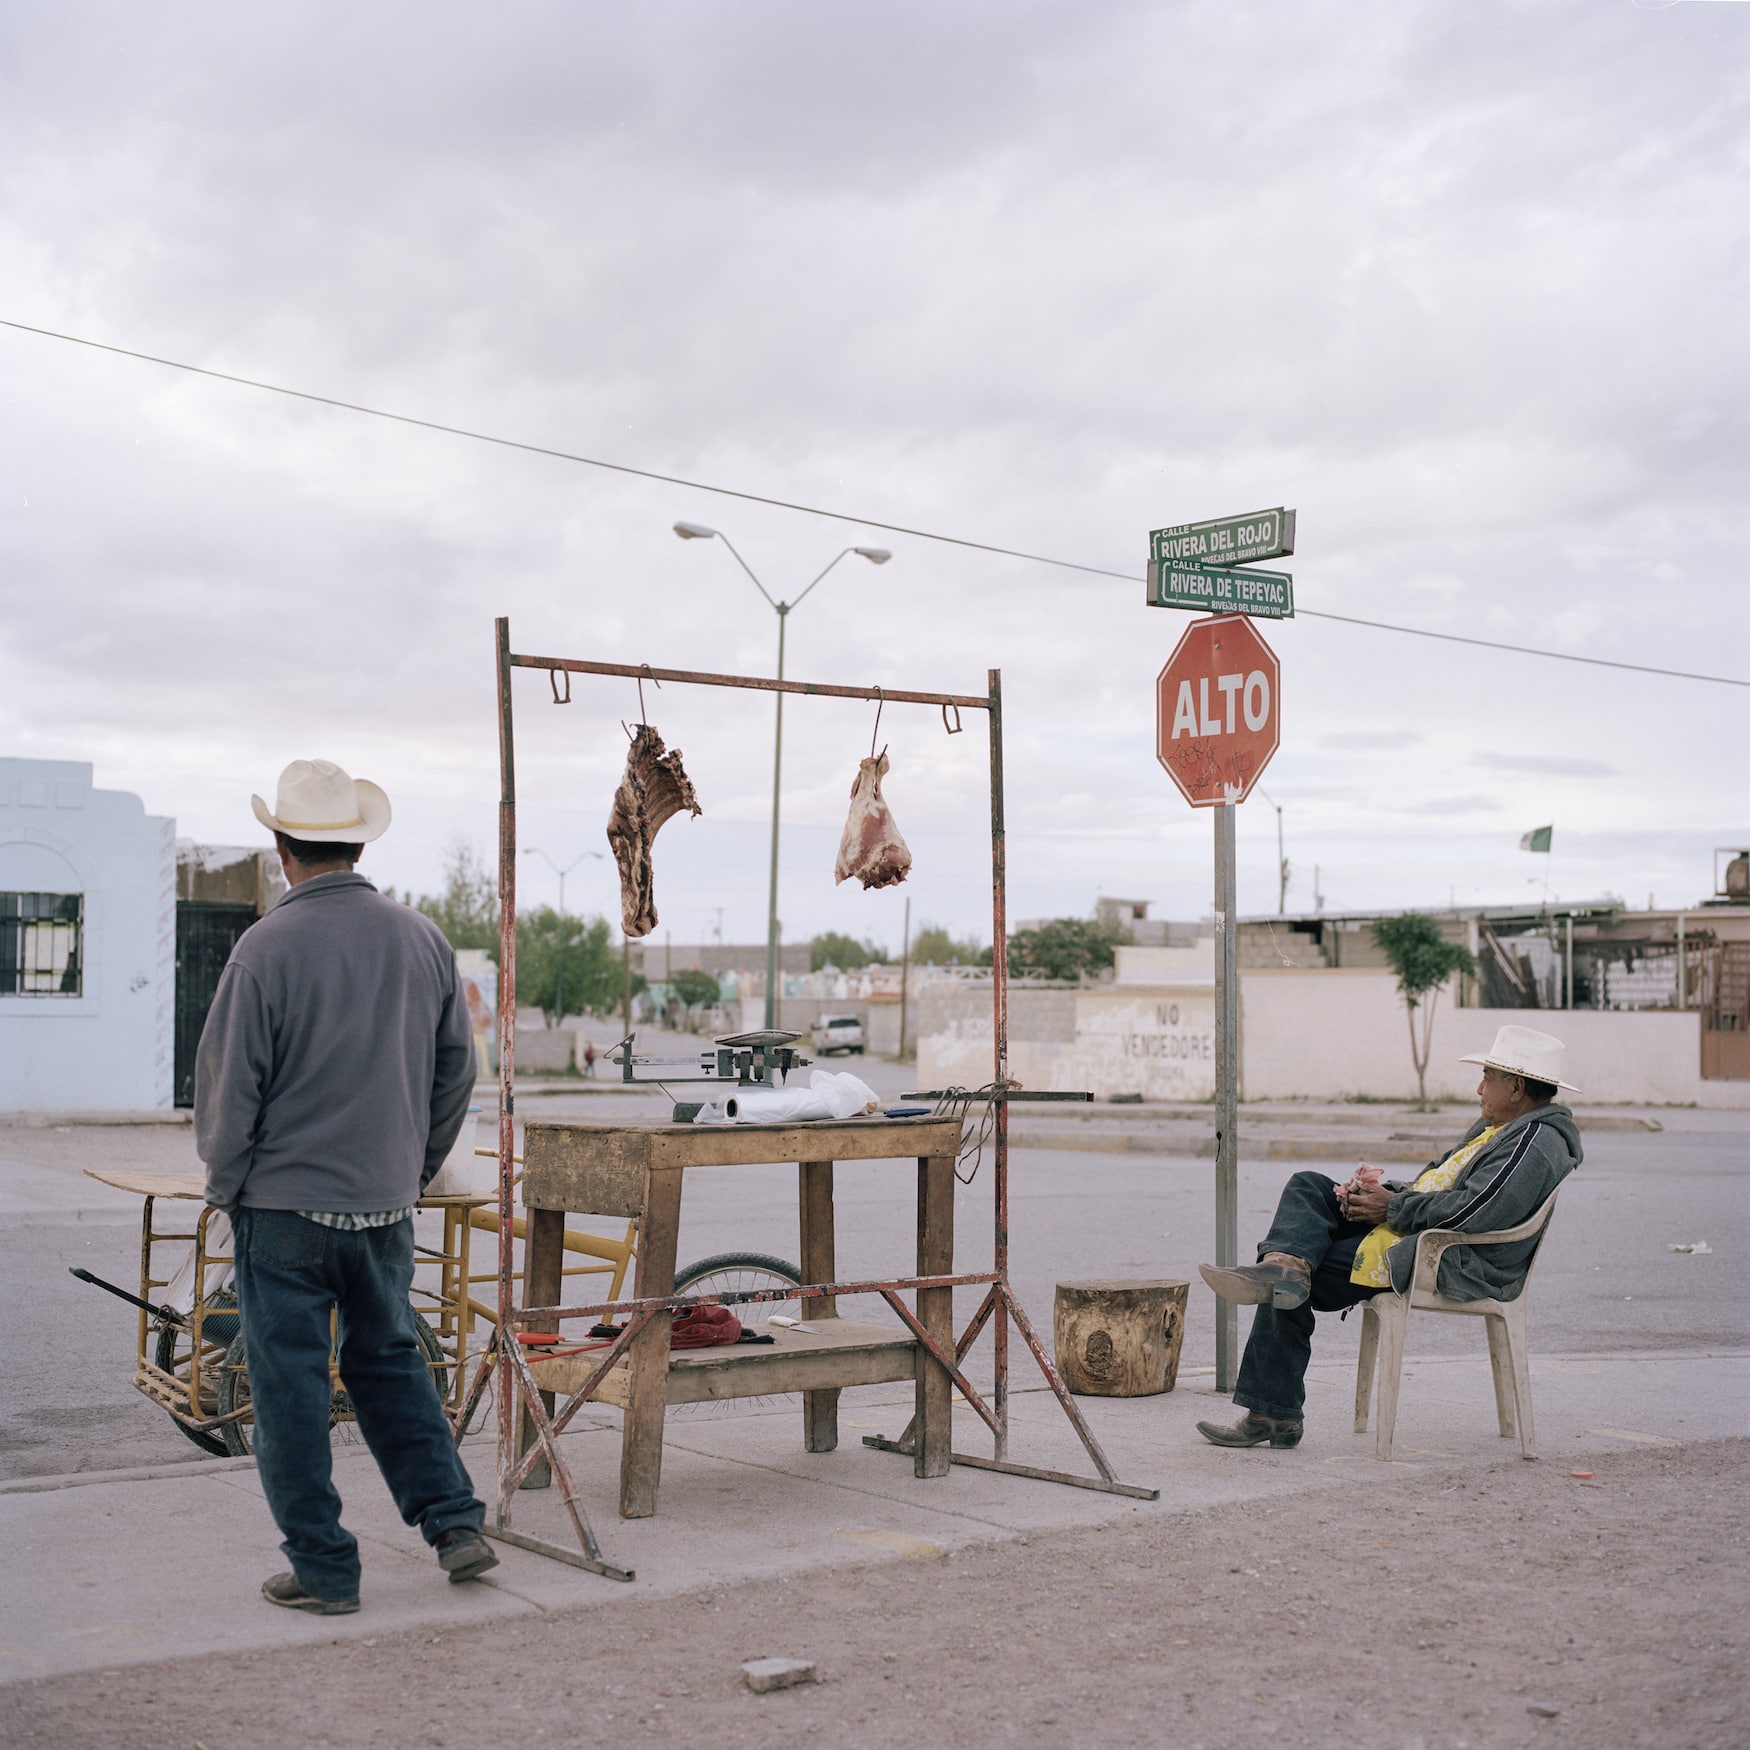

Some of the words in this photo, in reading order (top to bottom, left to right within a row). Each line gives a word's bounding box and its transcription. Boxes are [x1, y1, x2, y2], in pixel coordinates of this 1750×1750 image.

[1161, 535, 1207, 559] RIVERA
[1211, 529, 1234, 551] DEL
[1238, 521, 1271, 546] ROJO
[1162, 525, 1190, 538] CALLE
[1226, 551, 1236, 561] DEL
[1238, 547, 1256, 559] BRAVO
[1172, 560, 1200, 572] CALLE
[1170, 572, 1213, 597] RIVERA
[1216, 577, 1233, 598] DE
[1235, 580, 1284, 604] TEPEYAC
[1238, 603, 1250, 613] DEL
[1250, 604, 1270, 615] BRAVO
[1171, 669, 1270, 740] ALTO
[1156, 1003, 1179, 1026] NO
[1121, 1032, 1215, 1060] VENDEDORE
